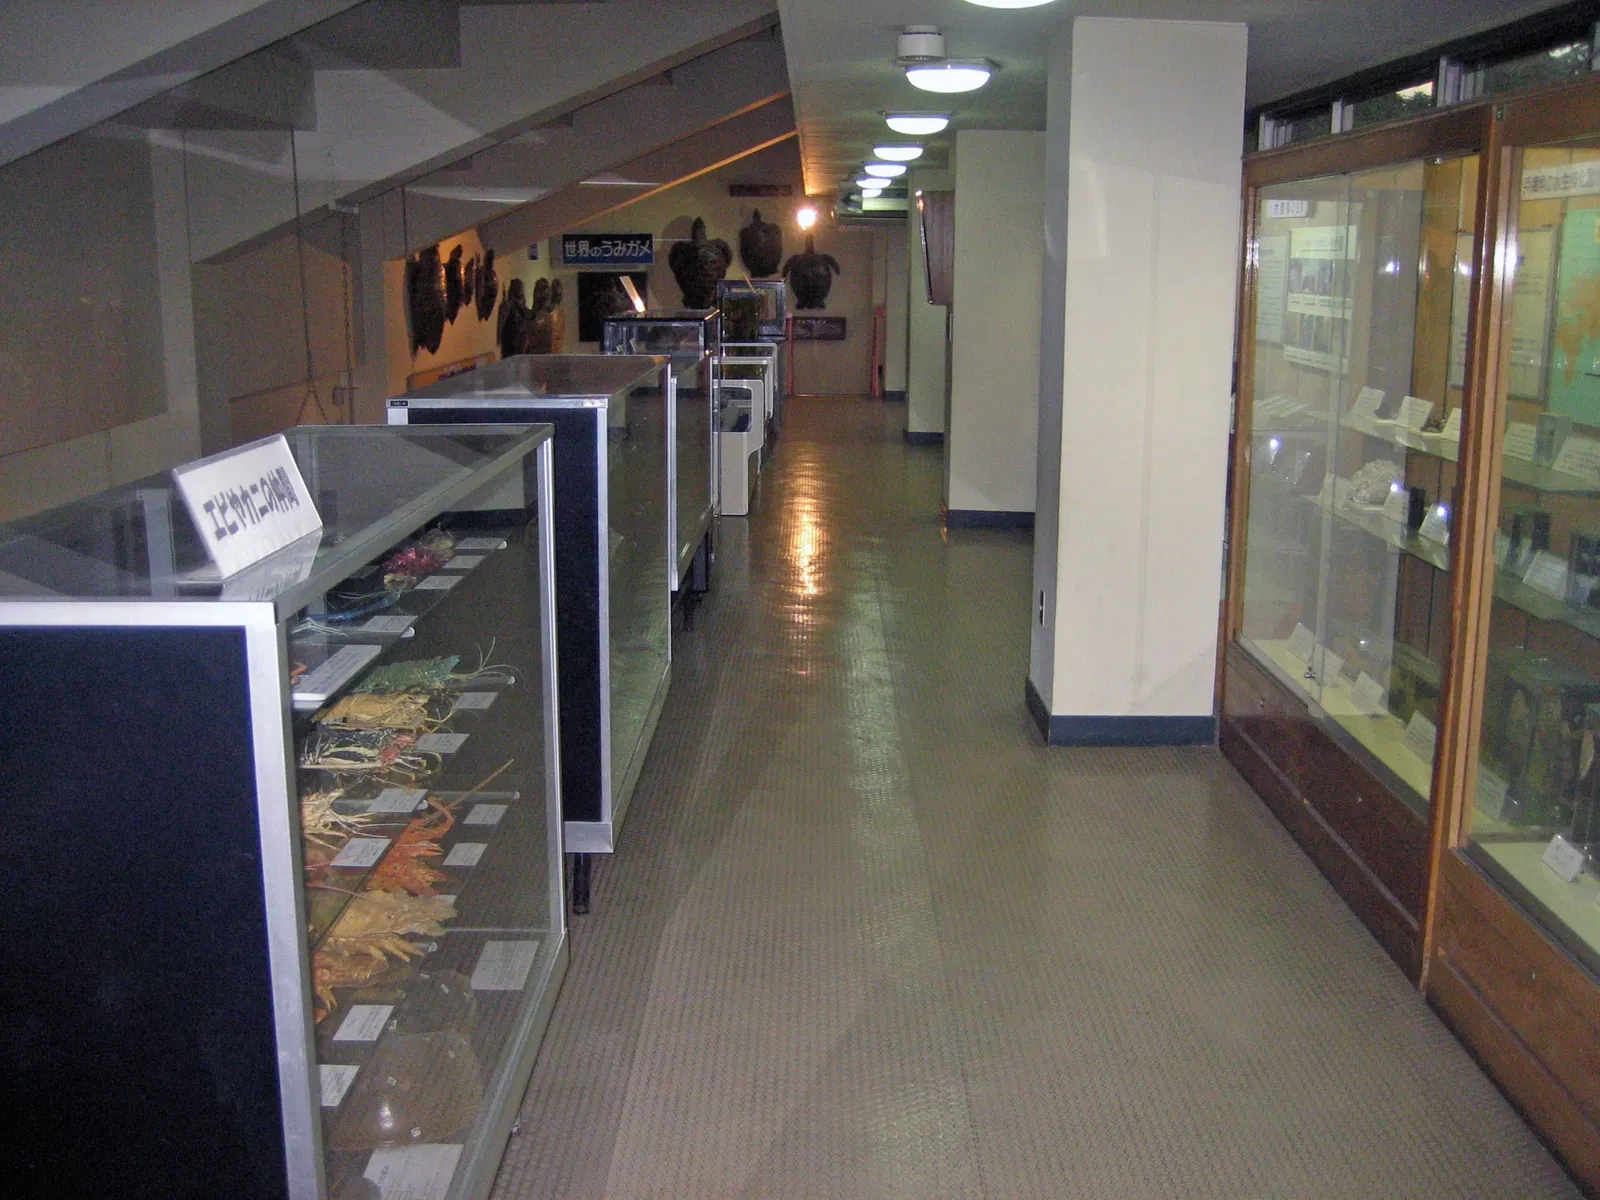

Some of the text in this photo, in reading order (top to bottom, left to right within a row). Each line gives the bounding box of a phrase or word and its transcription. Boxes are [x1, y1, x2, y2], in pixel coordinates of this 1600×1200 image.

[564, 240, 652, 257] 世界のうみガメ
[202, 465, 300, 541] エビやカニの仲間
